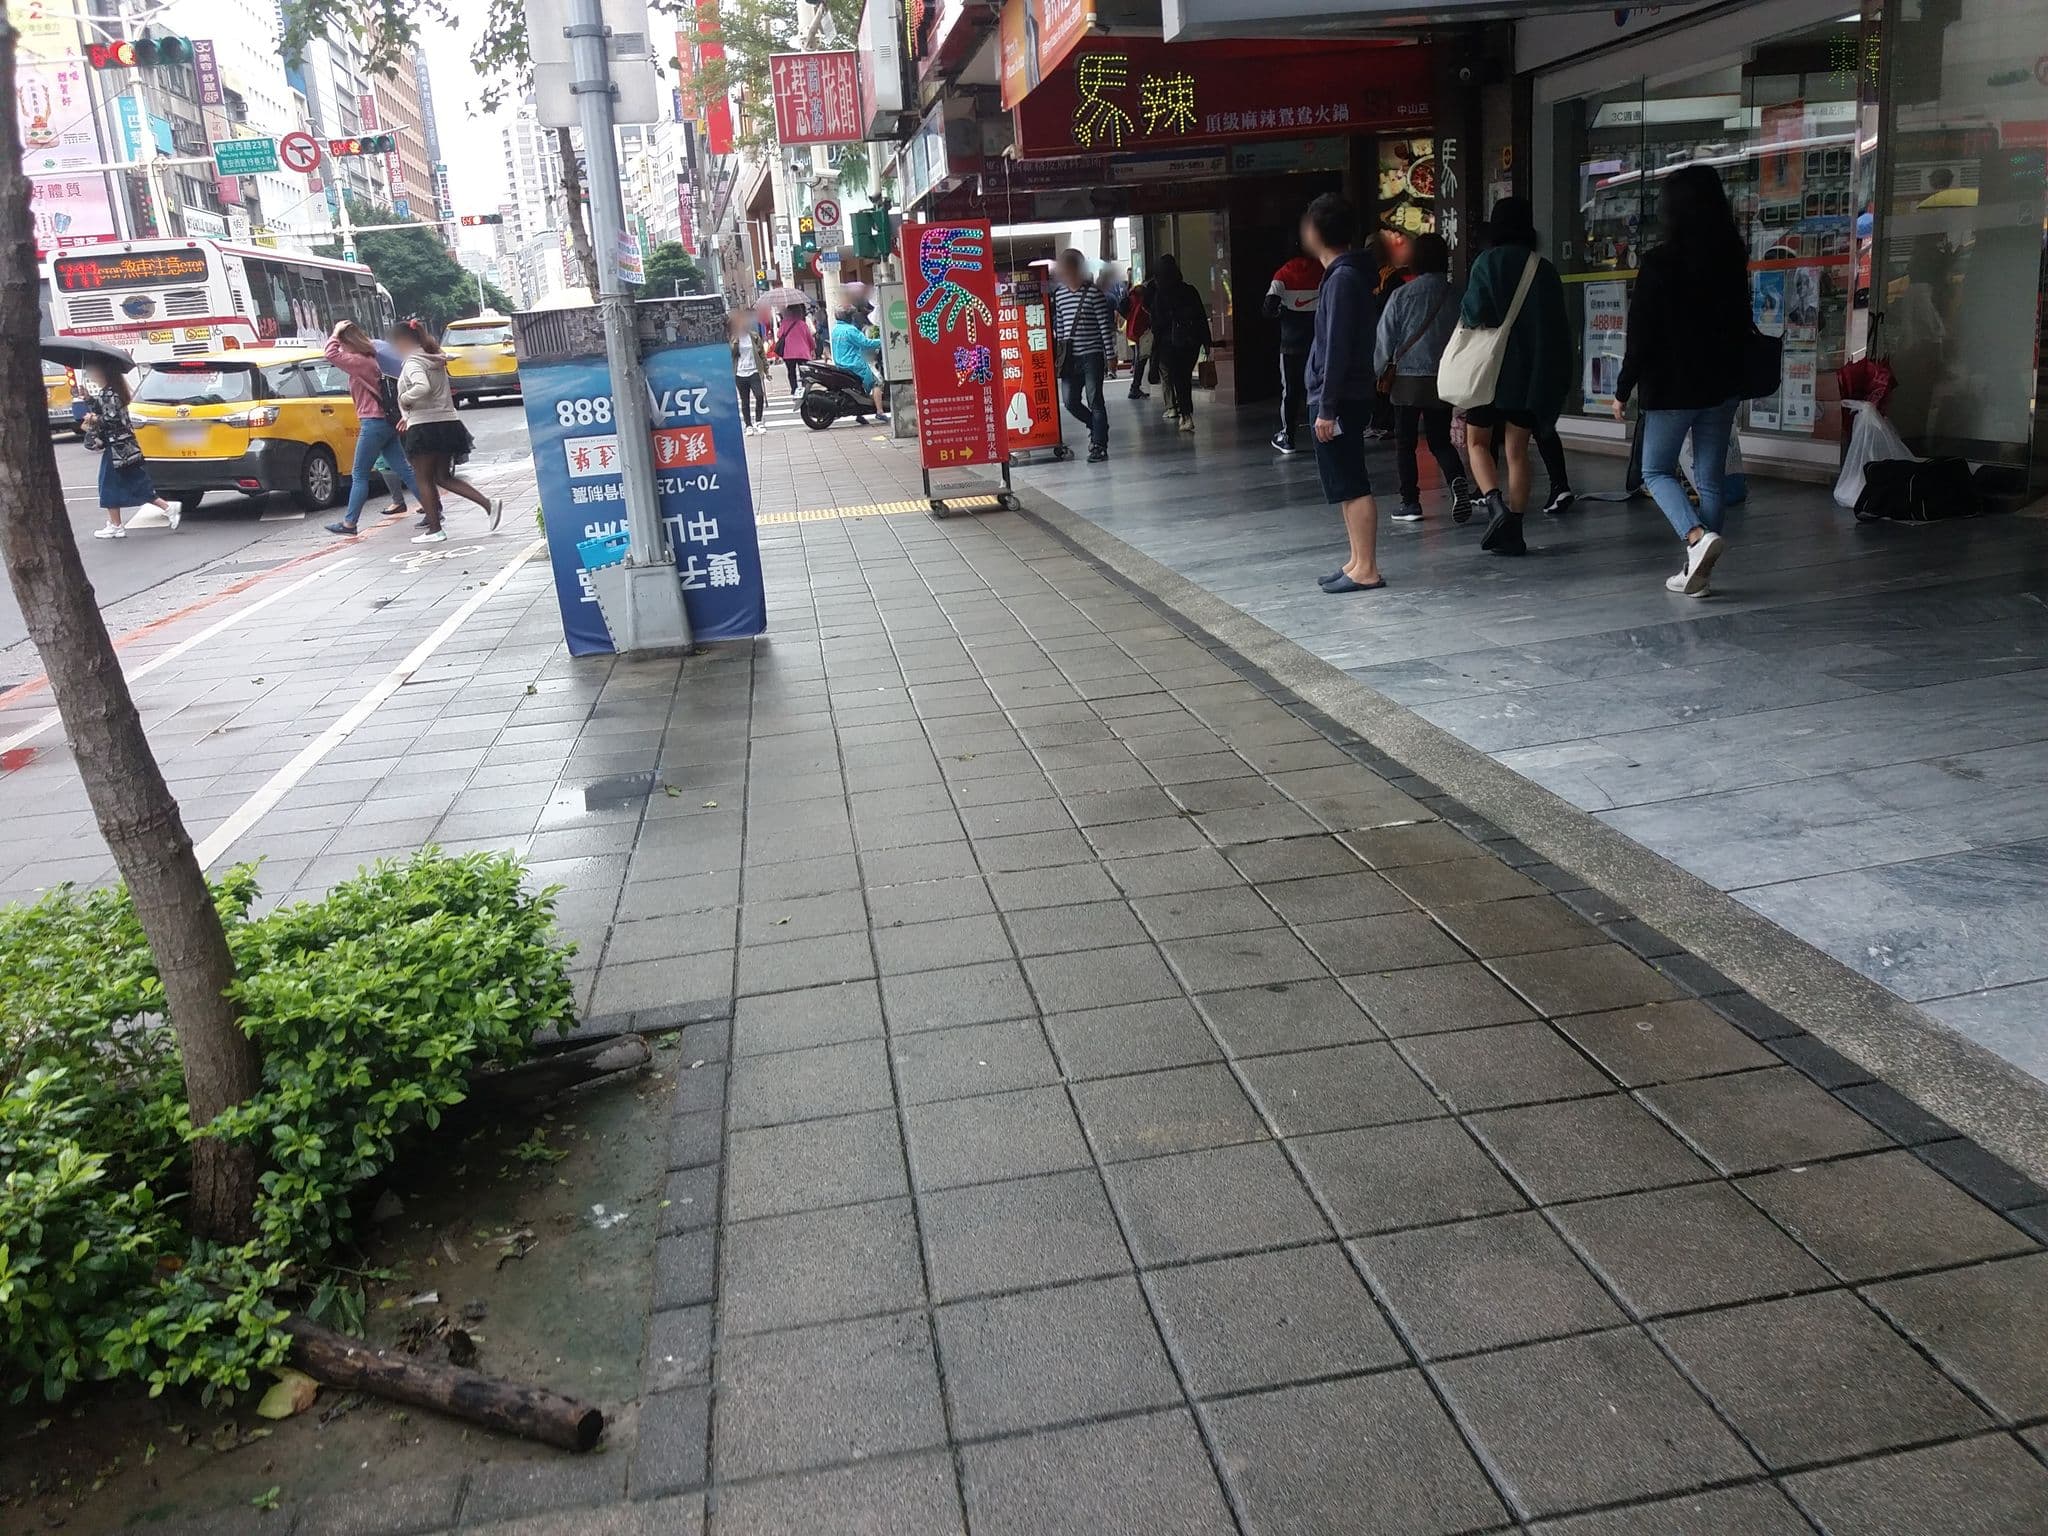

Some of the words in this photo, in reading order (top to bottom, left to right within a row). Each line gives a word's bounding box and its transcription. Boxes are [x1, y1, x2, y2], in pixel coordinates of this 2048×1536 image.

[1073, 53, 1197, 148] 馬辣
[218, 139, 270, 153] 南京西路23巷
[998, 308, 1018, 322] 200
[999, 328, 1018, 341] 265
[556, 396, 617, 427] 888
[940, 449, 955, 460] B1
